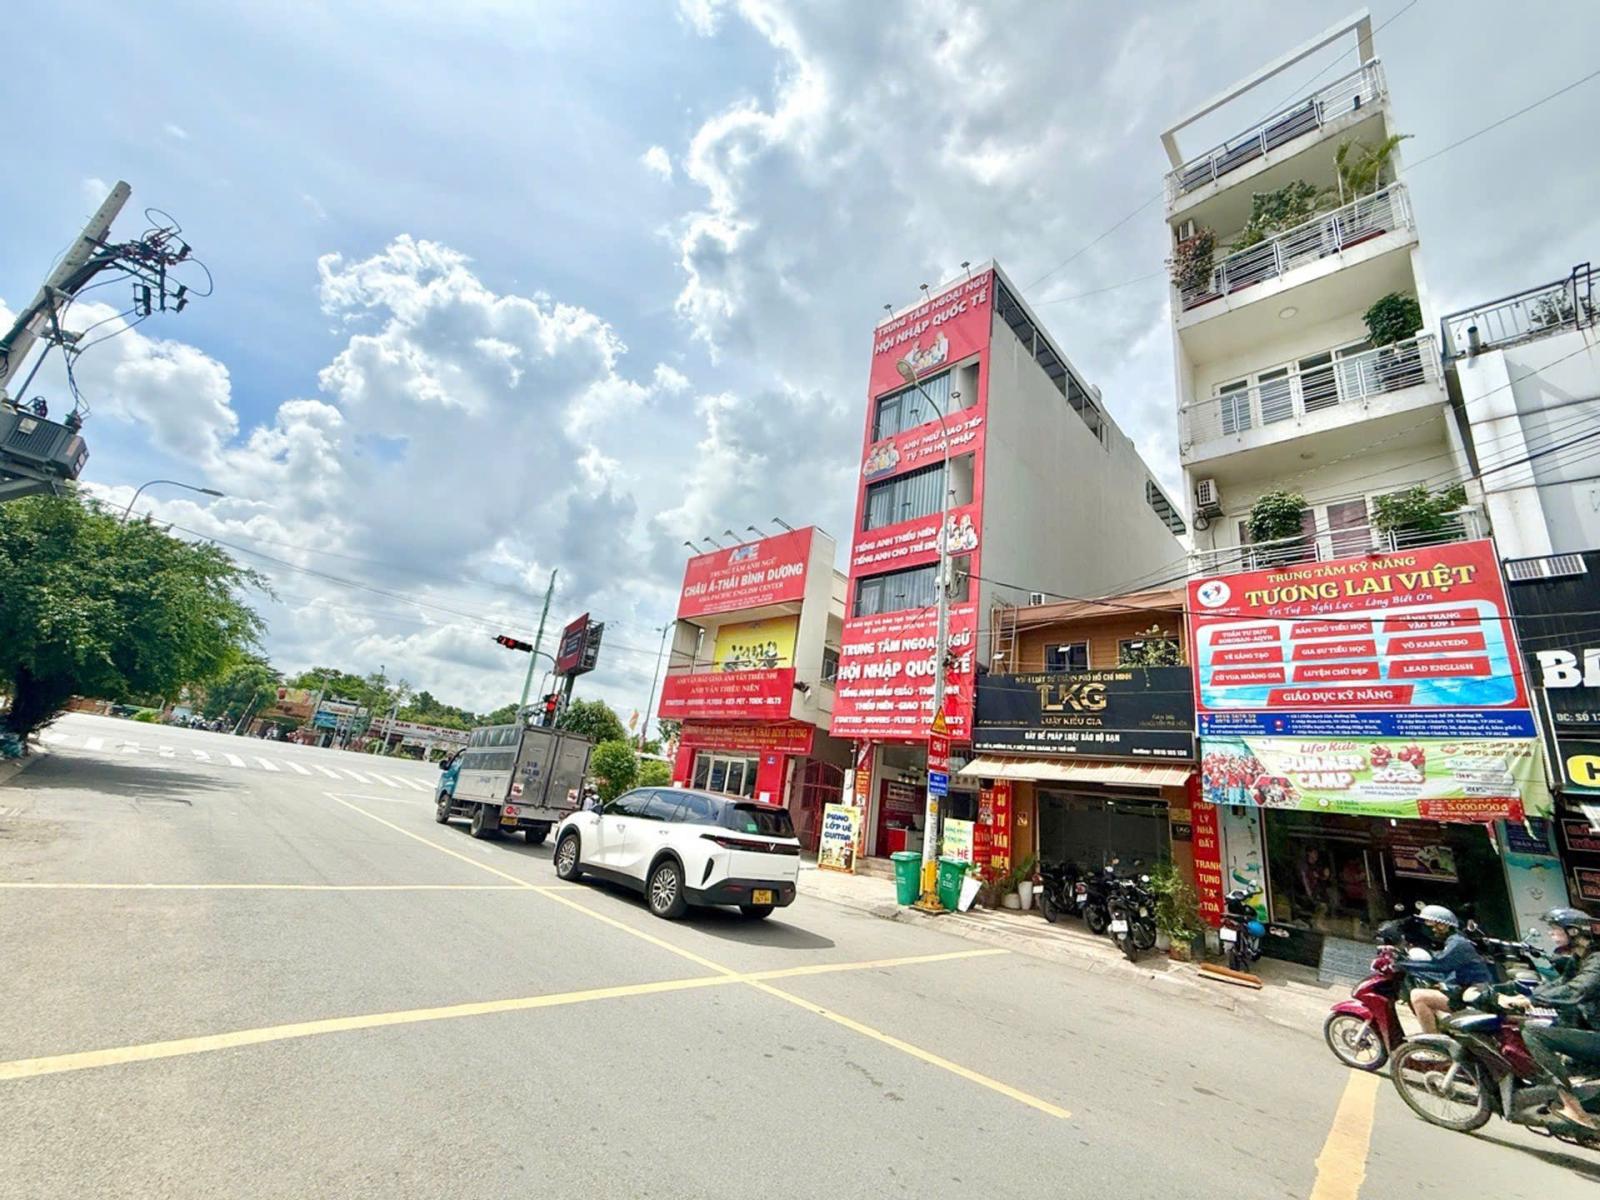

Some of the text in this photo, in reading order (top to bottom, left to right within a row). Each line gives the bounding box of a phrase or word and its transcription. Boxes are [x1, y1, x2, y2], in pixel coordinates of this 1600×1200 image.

[875, 285, 989, 354] HỘI NHẬP QUỐC TẾ
[879, 318, 906, 337] TRUNG
[909, 304, 930, 321] TÂM
[931, 288, 962, 311] NGOẠI
[934, 440, 947, 452] HỘ
[855, 540, 875, 553] TIẾNG
[876, 537, 894, 548] ANH
[894, 530, 916, 544] THIẾU
[853, 553, 874, 566] TIẾNG
[874, 550, 891, 561] ANH
[891, 547, 908, 557] CHO
[1266, 556, 1416, 583] TRUNG TÂM KỸ NĂNG
[684, 581, 707, 597] CHÂU
[741, 569, 764, 587] BÌNH
[767, 562, 803, 580] DƯƠNG
[1245, 562, 1477, 608] TƯƠNG LAI VIỆT
[842, 643, 875, 656] TRUNG
[878, 638, 900, 653] TÂM
[948, 629, 971, 646] GỮ
[1401, 638, 1469, 649] VÕ KARATEDO
[838, 661, 860, 683] HỘI
[863, 659, 902, 681] NHẬP
[905, 655, 937, 677] QUỐ
[1403, 664, 1428, 672] LEAD
[920, 698, 936, 710] TIẾ
[1036, 682, 1107, 711] LKG
[1282, 688, 1394, 702] GIÁO DỤC KỸ NĂNG
[1575, 710, 1589, 722] SỐ
[1280, 755, 1367, 773] SUMMER
[1297, 772, 1356, 790] CAMP
[825, 821, 841, 830] LỚP
[826, 813, 849, 822] PIANO
[824, 831, 851, 840] GUITAR
[1199, 873, 1220, 885] TỤNG
